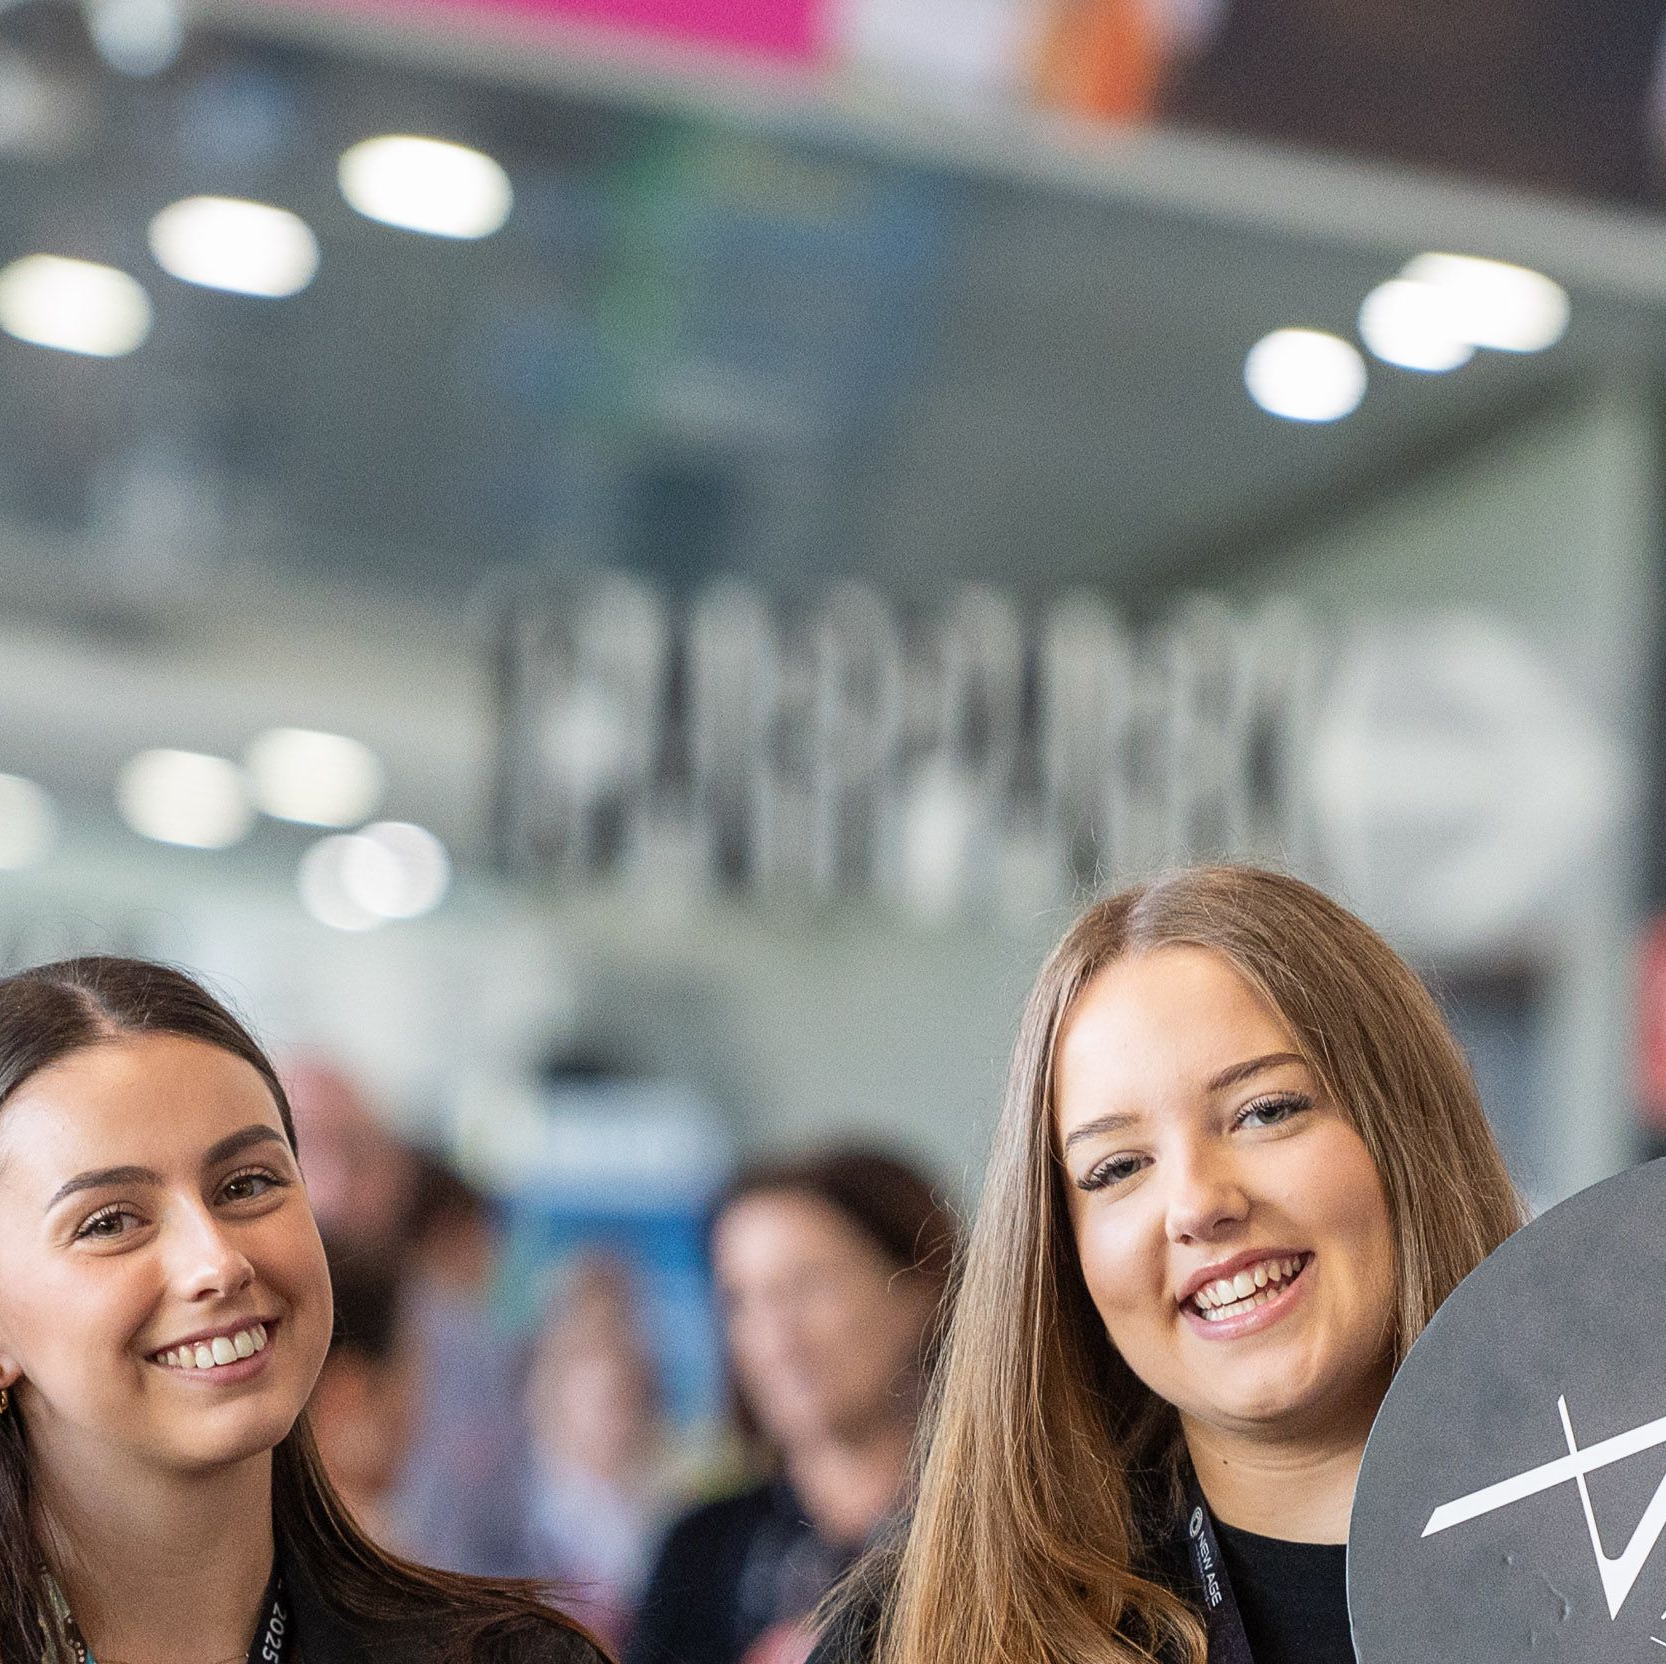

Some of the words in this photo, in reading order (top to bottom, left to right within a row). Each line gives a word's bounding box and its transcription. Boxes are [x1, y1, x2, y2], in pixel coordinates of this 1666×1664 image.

[1197, 1531, 1213, 1571] NEW
[1206, 1572, 1223, 1608] AGE
[262, 1602, 287, 1664] 2025
